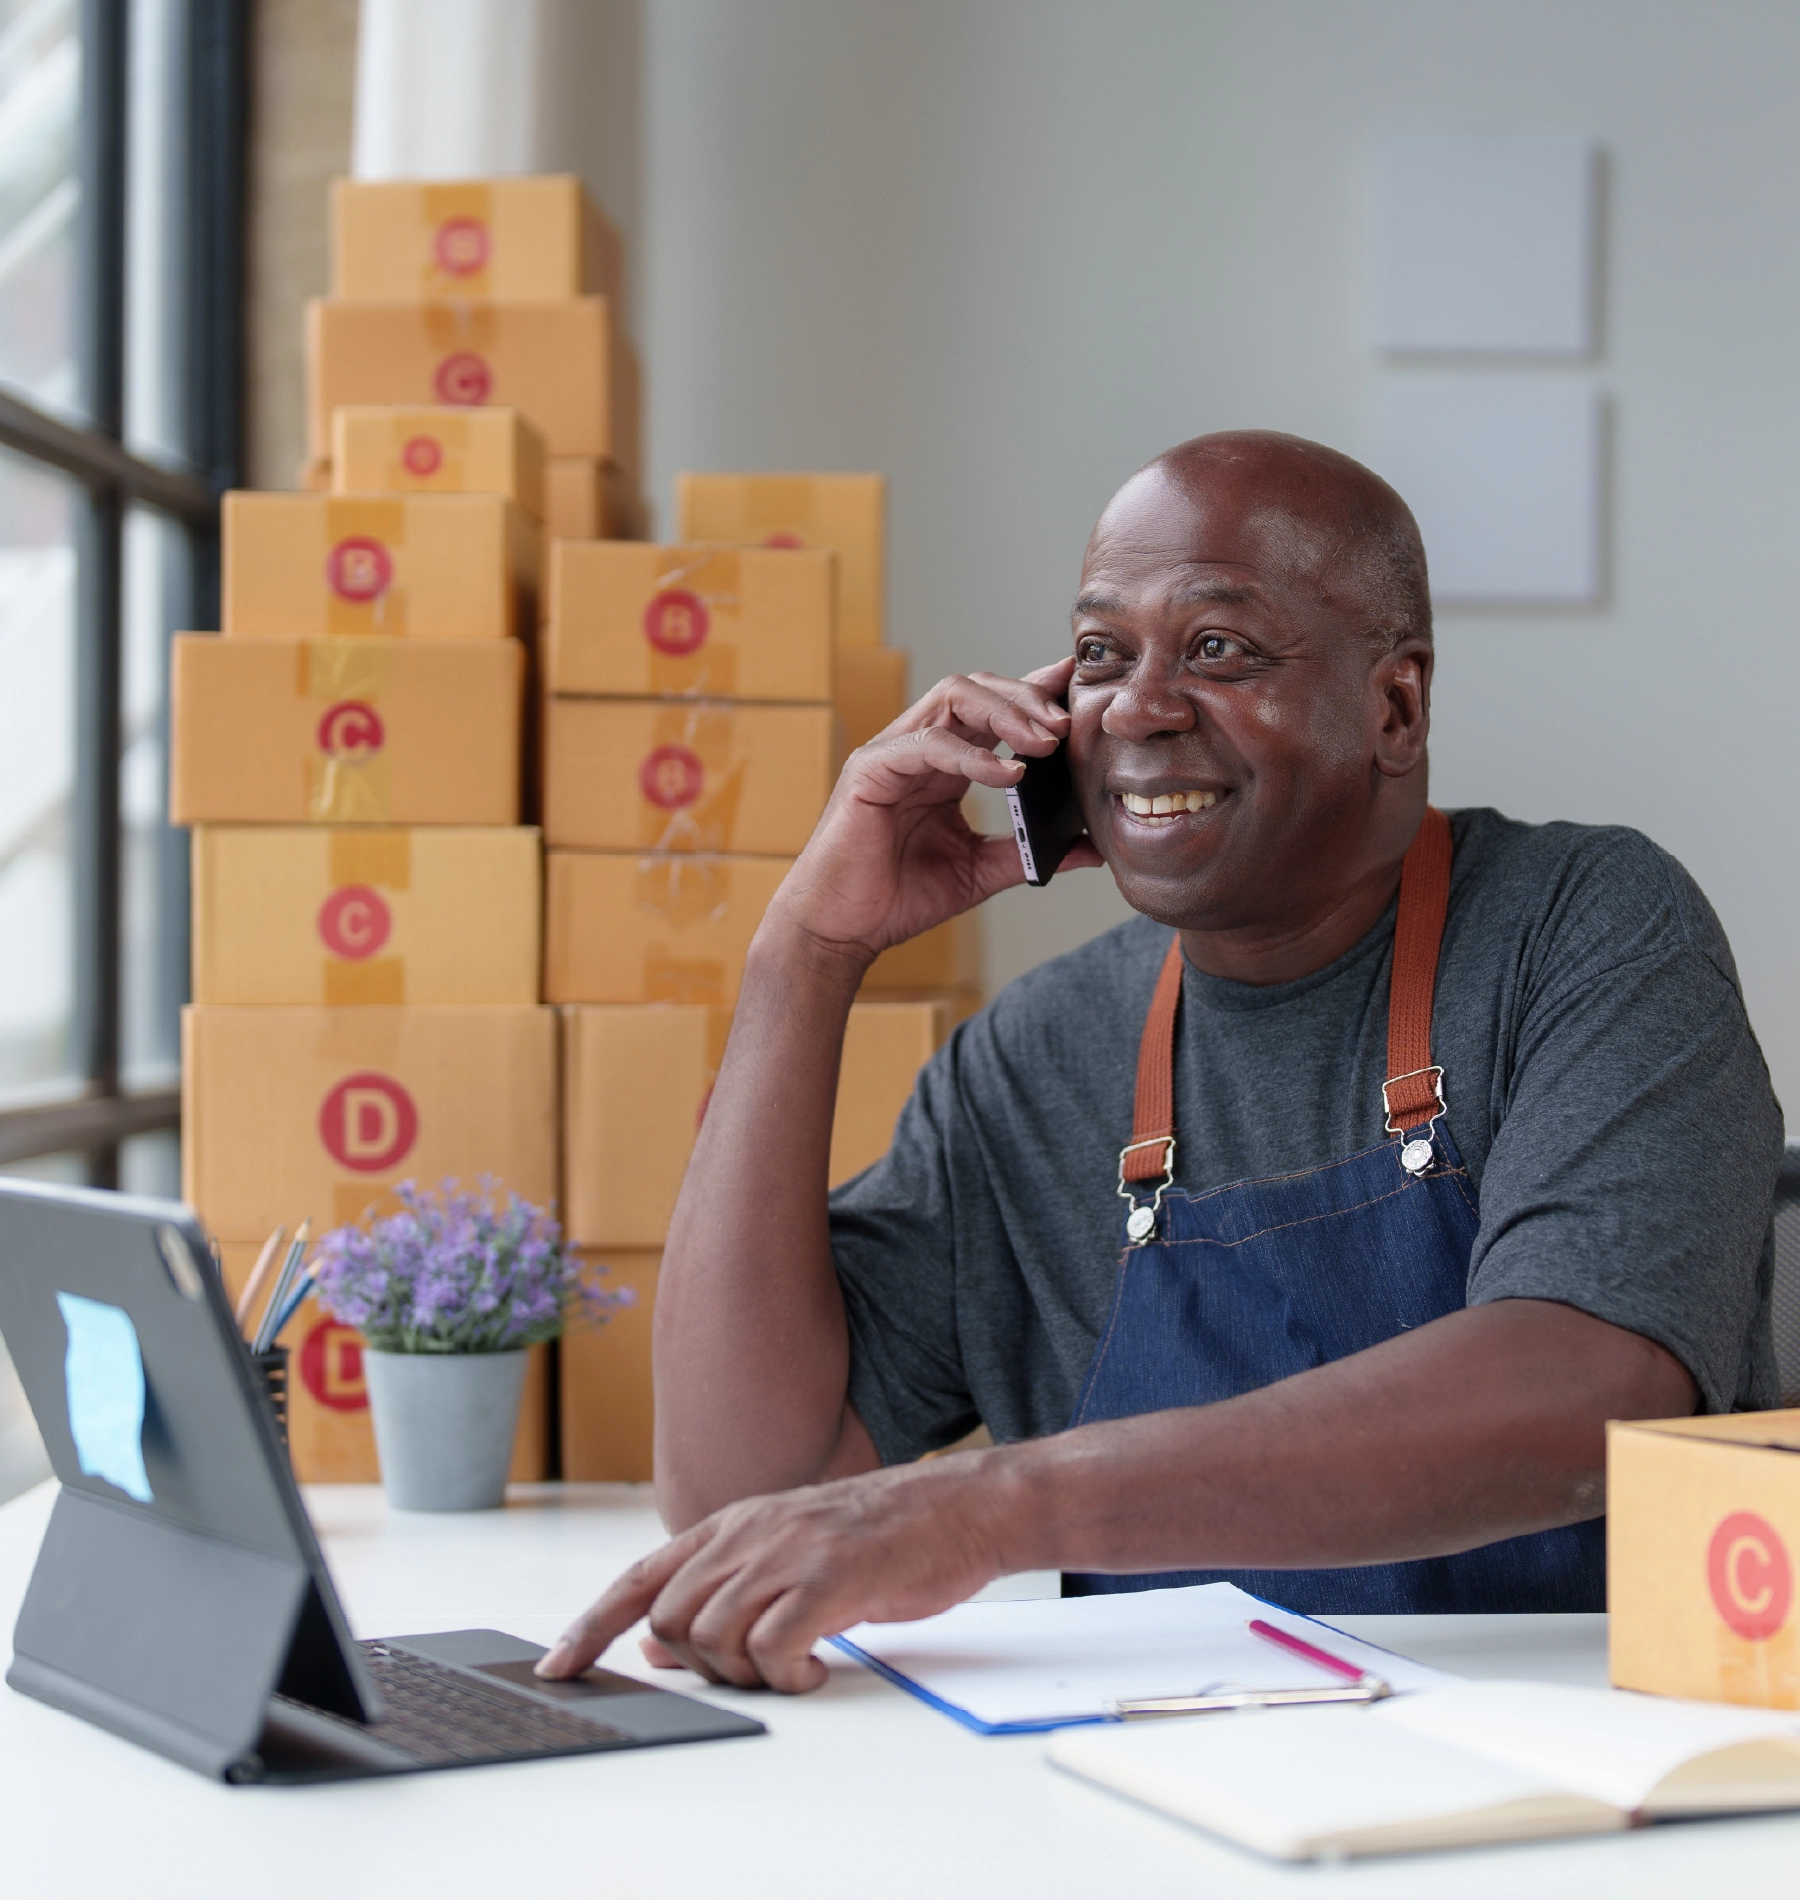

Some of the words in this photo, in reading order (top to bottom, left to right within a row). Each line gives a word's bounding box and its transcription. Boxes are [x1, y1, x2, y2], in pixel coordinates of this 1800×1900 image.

[332, 709, 370, 758] C
[337, 900, 372, 946] C
[343, 1087, 399, 1159] D
[1725, 1534, 1774, 1615] C
